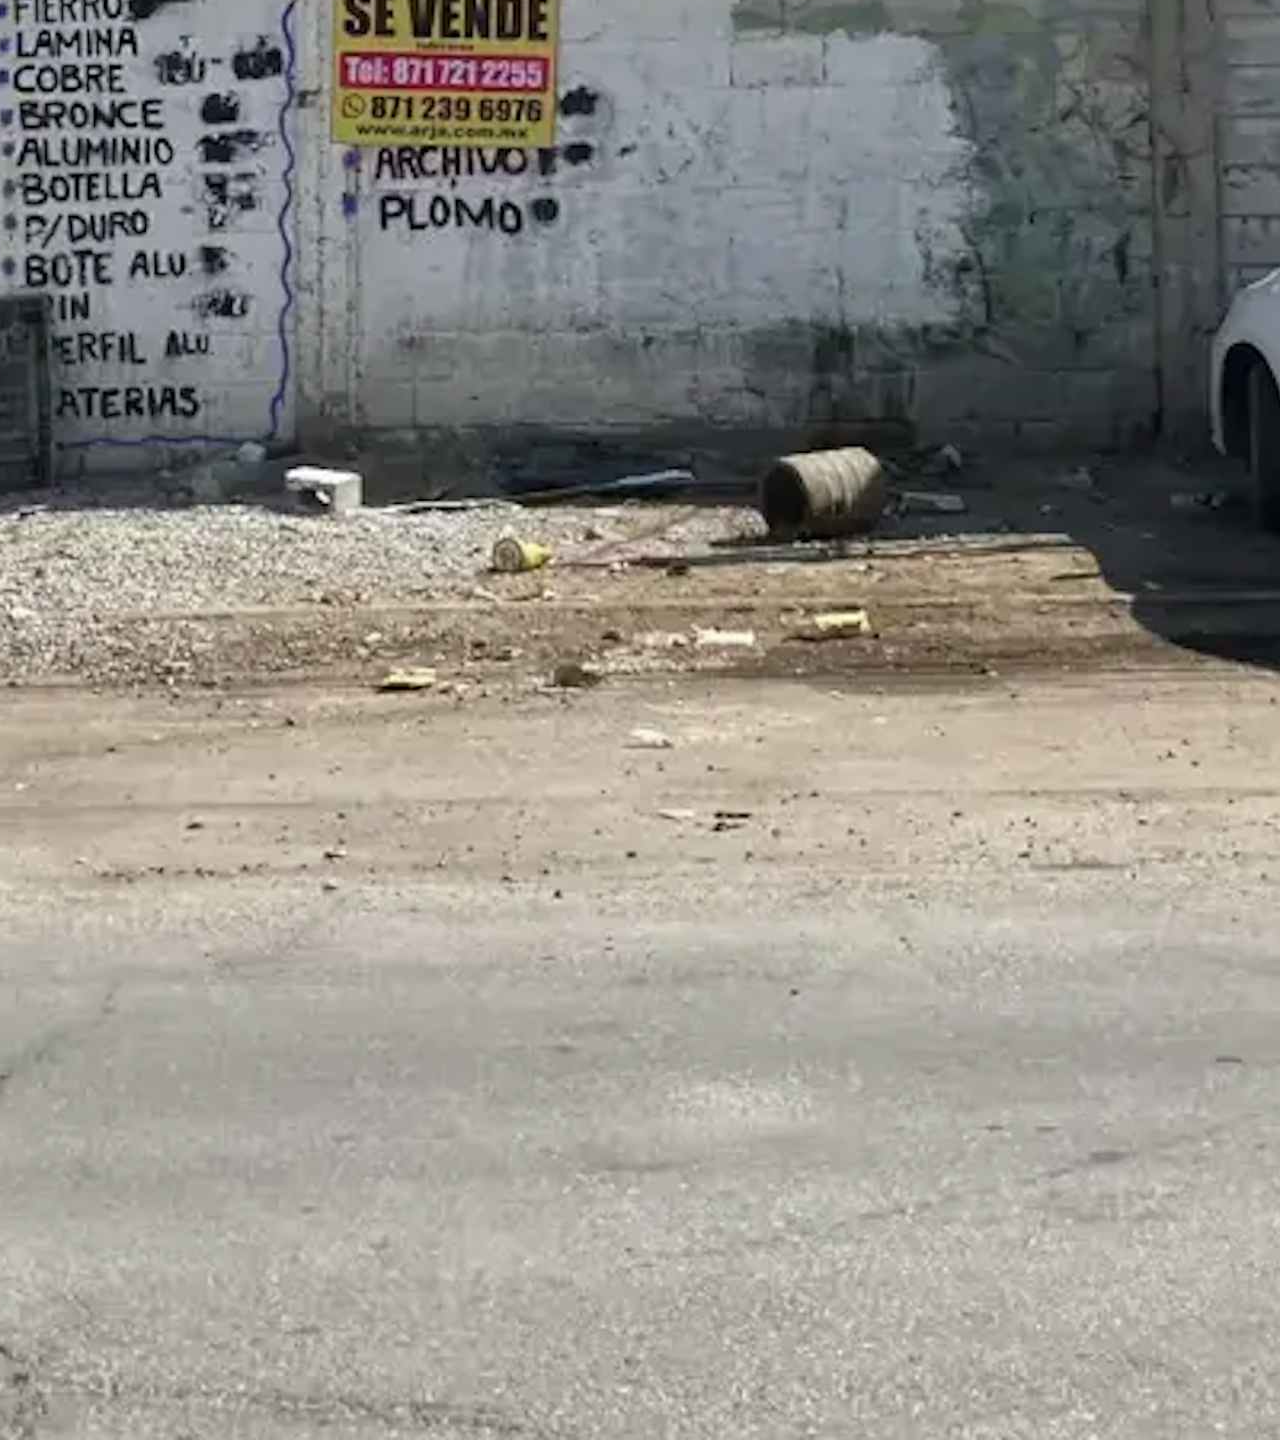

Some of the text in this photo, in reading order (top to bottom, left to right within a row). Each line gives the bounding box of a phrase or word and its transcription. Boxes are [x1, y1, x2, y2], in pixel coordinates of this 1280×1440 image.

[15, 29, 139, 59] LAMINA
[12, 63, 126, 94] COBRE
[345, 55, 544, 89] Tel: 871 721 2255
[17, 99, 165, 131] BRONCE
[371, 95, 543, 124] 871 239 6976
[16, 137, 175, 167] ALUMINIO
[375, 146, 529, 182] ARCHIVO
[21, 171, 163, 207] BOTELLA
[25, 211, 150, 248] P/DURO
[379, 194, 522, 236] PLOMO
[25, 250, 114, 288] BOTE
[55, 386, 201, 420] ATERIAS
